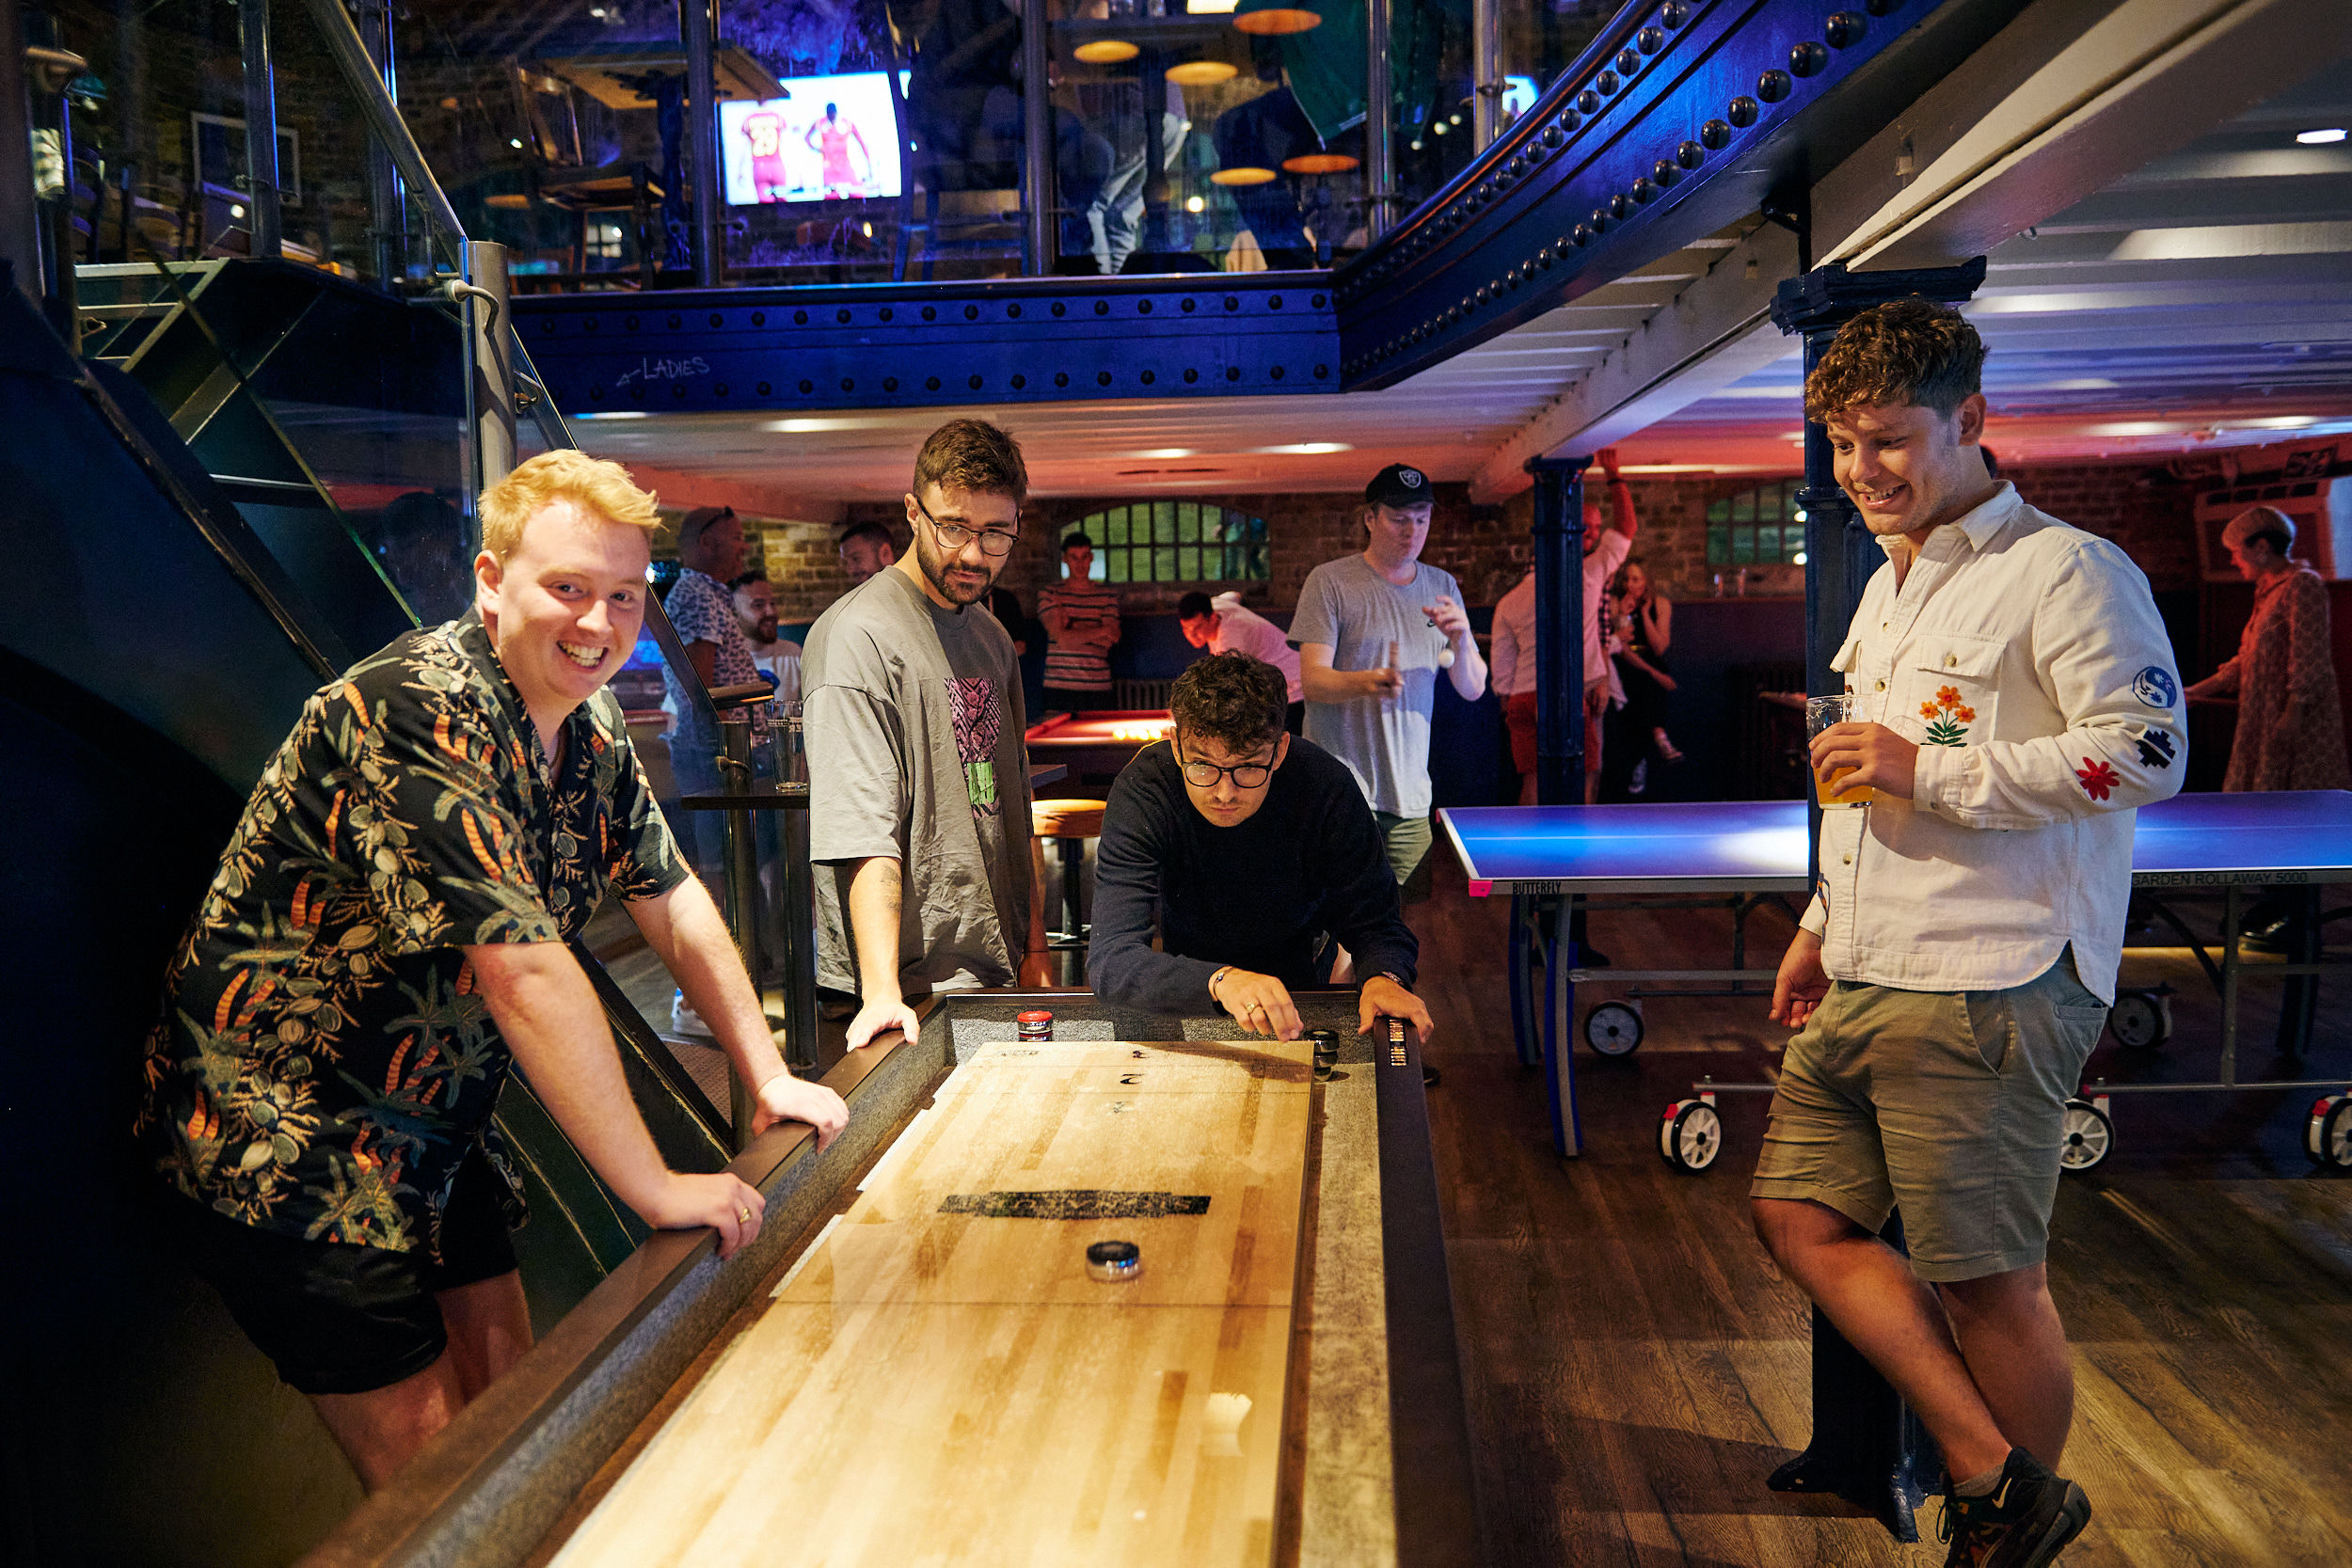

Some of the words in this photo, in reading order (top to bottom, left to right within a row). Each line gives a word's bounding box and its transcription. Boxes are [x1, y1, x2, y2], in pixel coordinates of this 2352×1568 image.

[643, 356, 710, 380] LADIES
[2132, 874, 2191, 887] GARDEN
[2195, 872, 2271, 885] ROLLAWAY
[2276, 871, 2308, 883] 5000
[1512, 880, 1562, 895] BUTTERFLY
